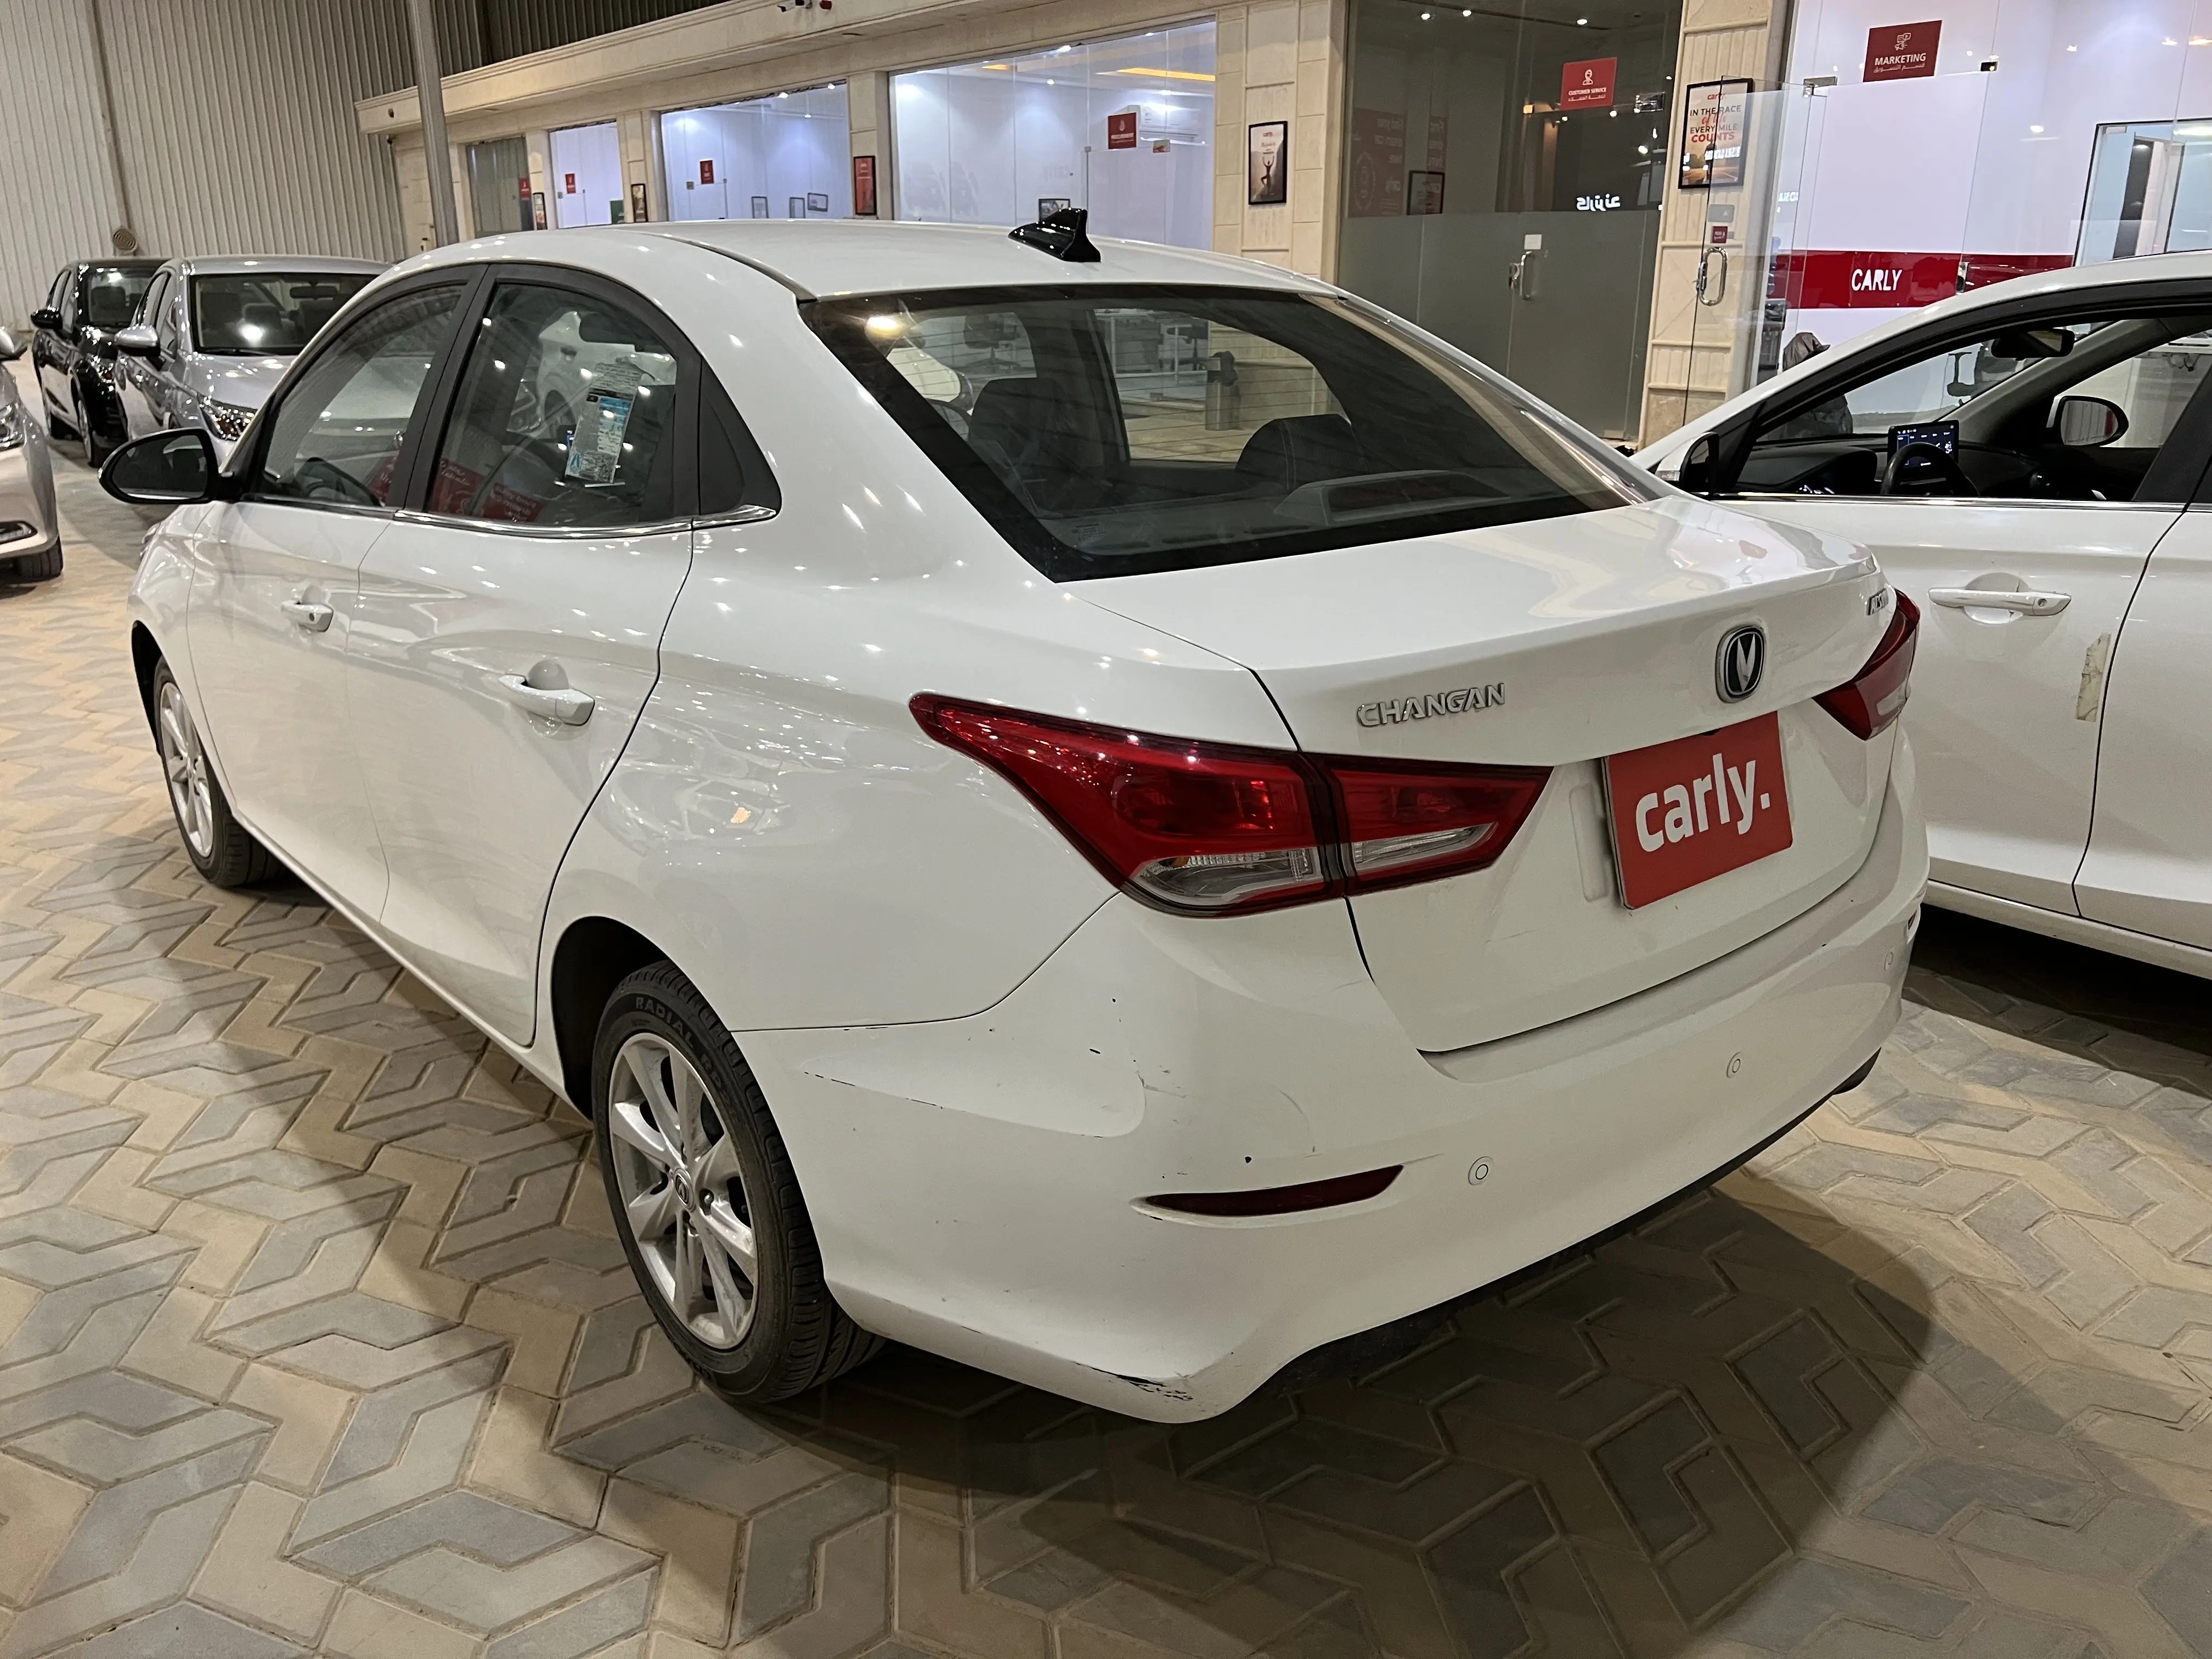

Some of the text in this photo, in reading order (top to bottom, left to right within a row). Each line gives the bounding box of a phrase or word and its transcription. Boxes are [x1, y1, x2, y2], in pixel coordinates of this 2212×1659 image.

[1875, 53, 1927, 66] MARKETING
[1690, 108, 1699, 116] IN
[1701, 107, 1717, 115] THE
[1690, 123, 1738, 134] EVERY MILE
[1851, 268, 1903, 291] CARLY
[1357, 683, 1505, 727] CHANGAN
[1635, 753, 1770, 853] carly.
[636, 996, 694, 1048] RADIAL
